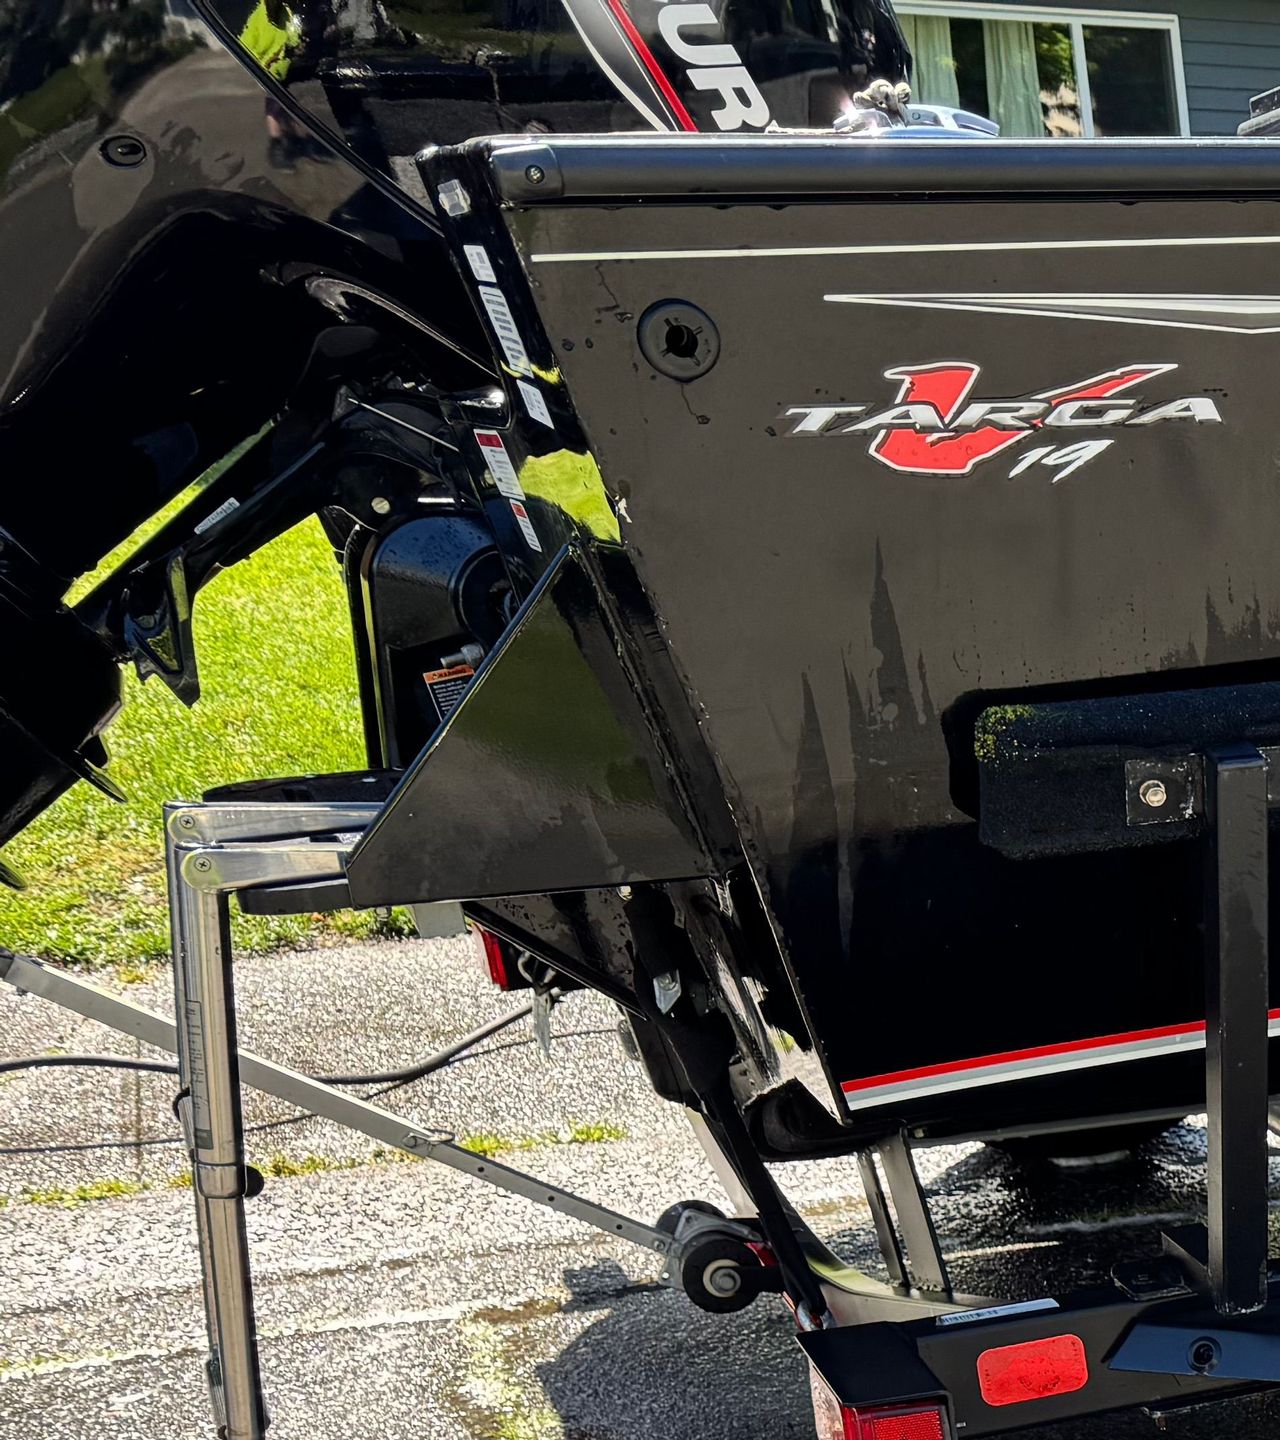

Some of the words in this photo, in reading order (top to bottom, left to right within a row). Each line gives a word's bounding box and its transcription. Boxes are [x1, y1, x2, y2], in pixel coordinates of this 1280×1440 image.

[650, 0, 770, 131] UR
[783, 397, 1224, 435] TARGA
[1008, 439, 1115, 484] 19
